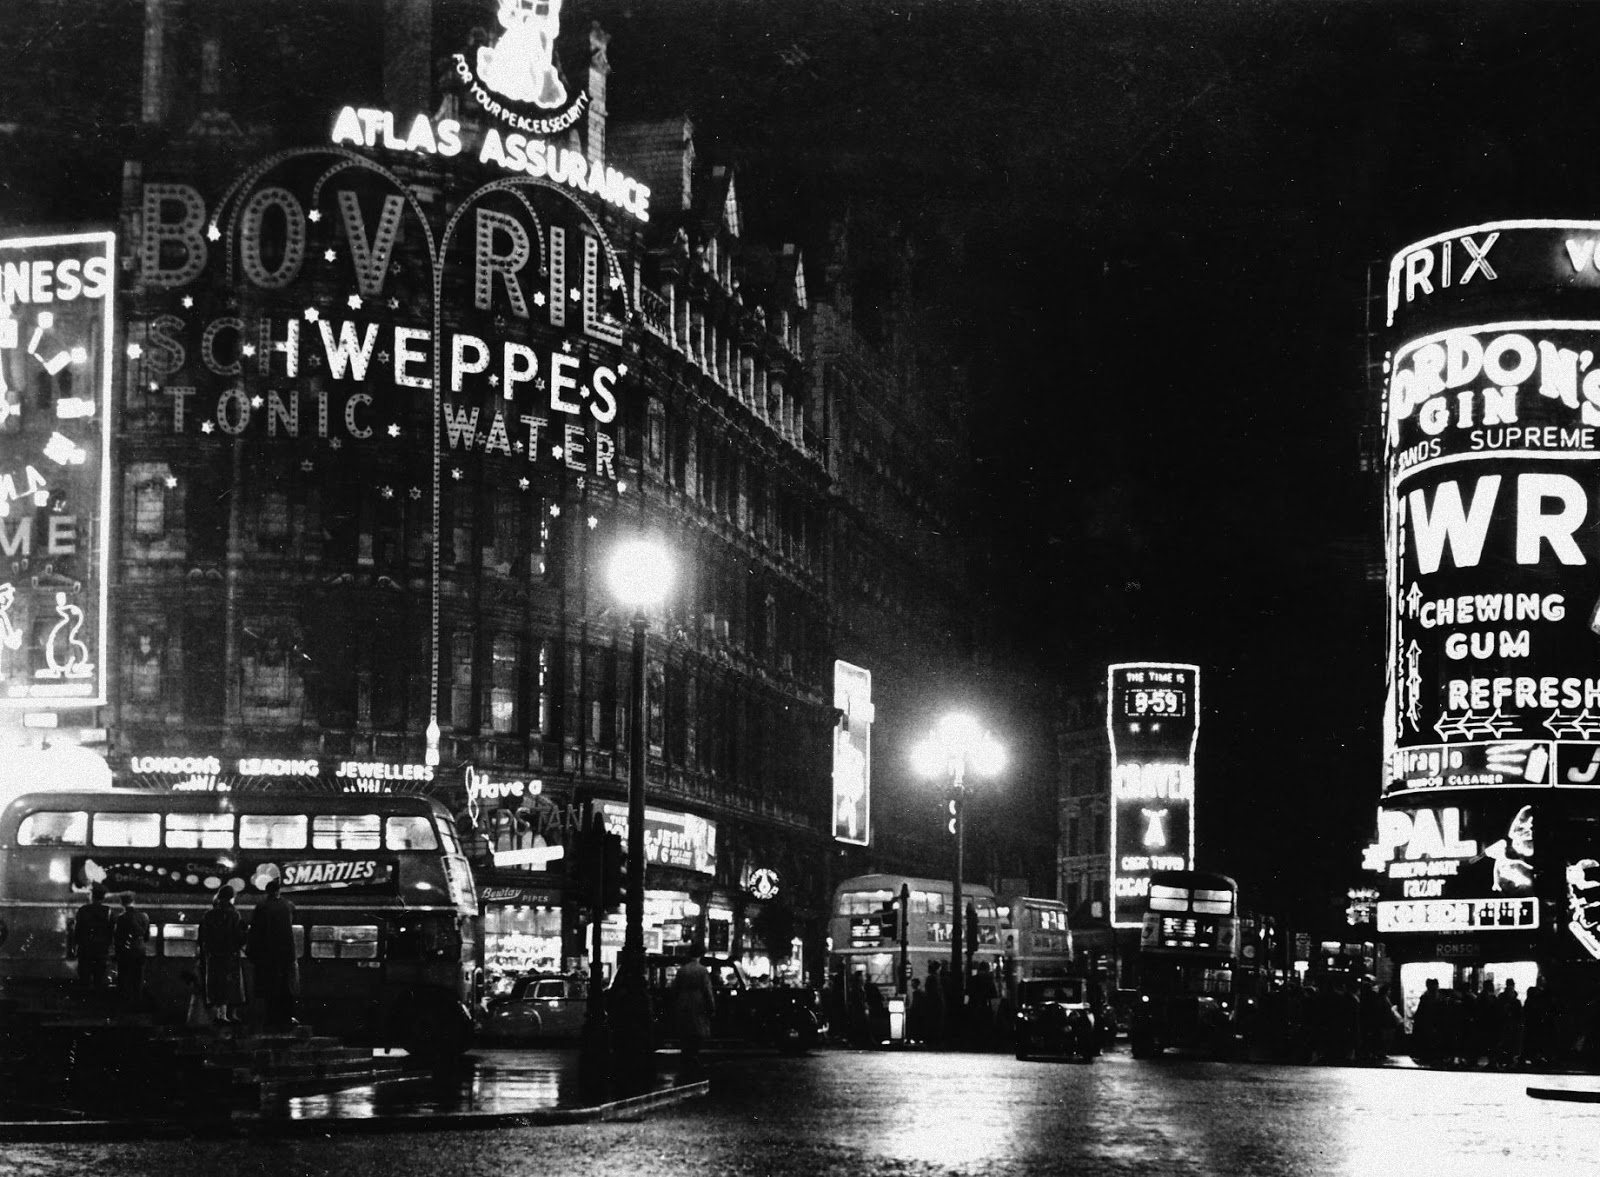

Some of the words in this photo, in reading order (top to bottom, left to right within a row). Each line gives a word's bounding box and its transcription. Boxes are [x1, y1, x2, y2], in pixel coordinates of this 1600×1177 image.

[452, 53, 473, 84] FOR
[470, 81, 502, 118] YOUR
[331, 105, 462, 157] ATLAS
[479, 127, 651, 223] ASSURANCE
[0, 256, 108, 304] NESS
[142, 183, 624, 346] BOVRIL
[146, 316, 618, 424] SCHWEPPES
[164, 385, 374, 439] TONIC
[1419, 385, 1519, 436] GIN
[442, 402, 618, 481] WATER
[1470, 426, 1596, 450] SUPREME
[1420, 593, 1566, 629] CHEWING
[1445, 630, 1530, 660] GUM
[1126, 671, 1144, 683] THE
[1148, 670, 1173, 683] TIME
[1449, 677, 1600, 710] REFRESH
[131, 755, 221, 775] LONDON'S
[239, 758, 320, 778] LEADING
[335, 761, 434, 782] JEWELLERS
[1448, 774, 1503, 786] CLEANER
[1377, 807, 1478, 861] PAL
[283, 860, 377, 885] SMARTIES
[1203, 925, 1213, 934] 14
